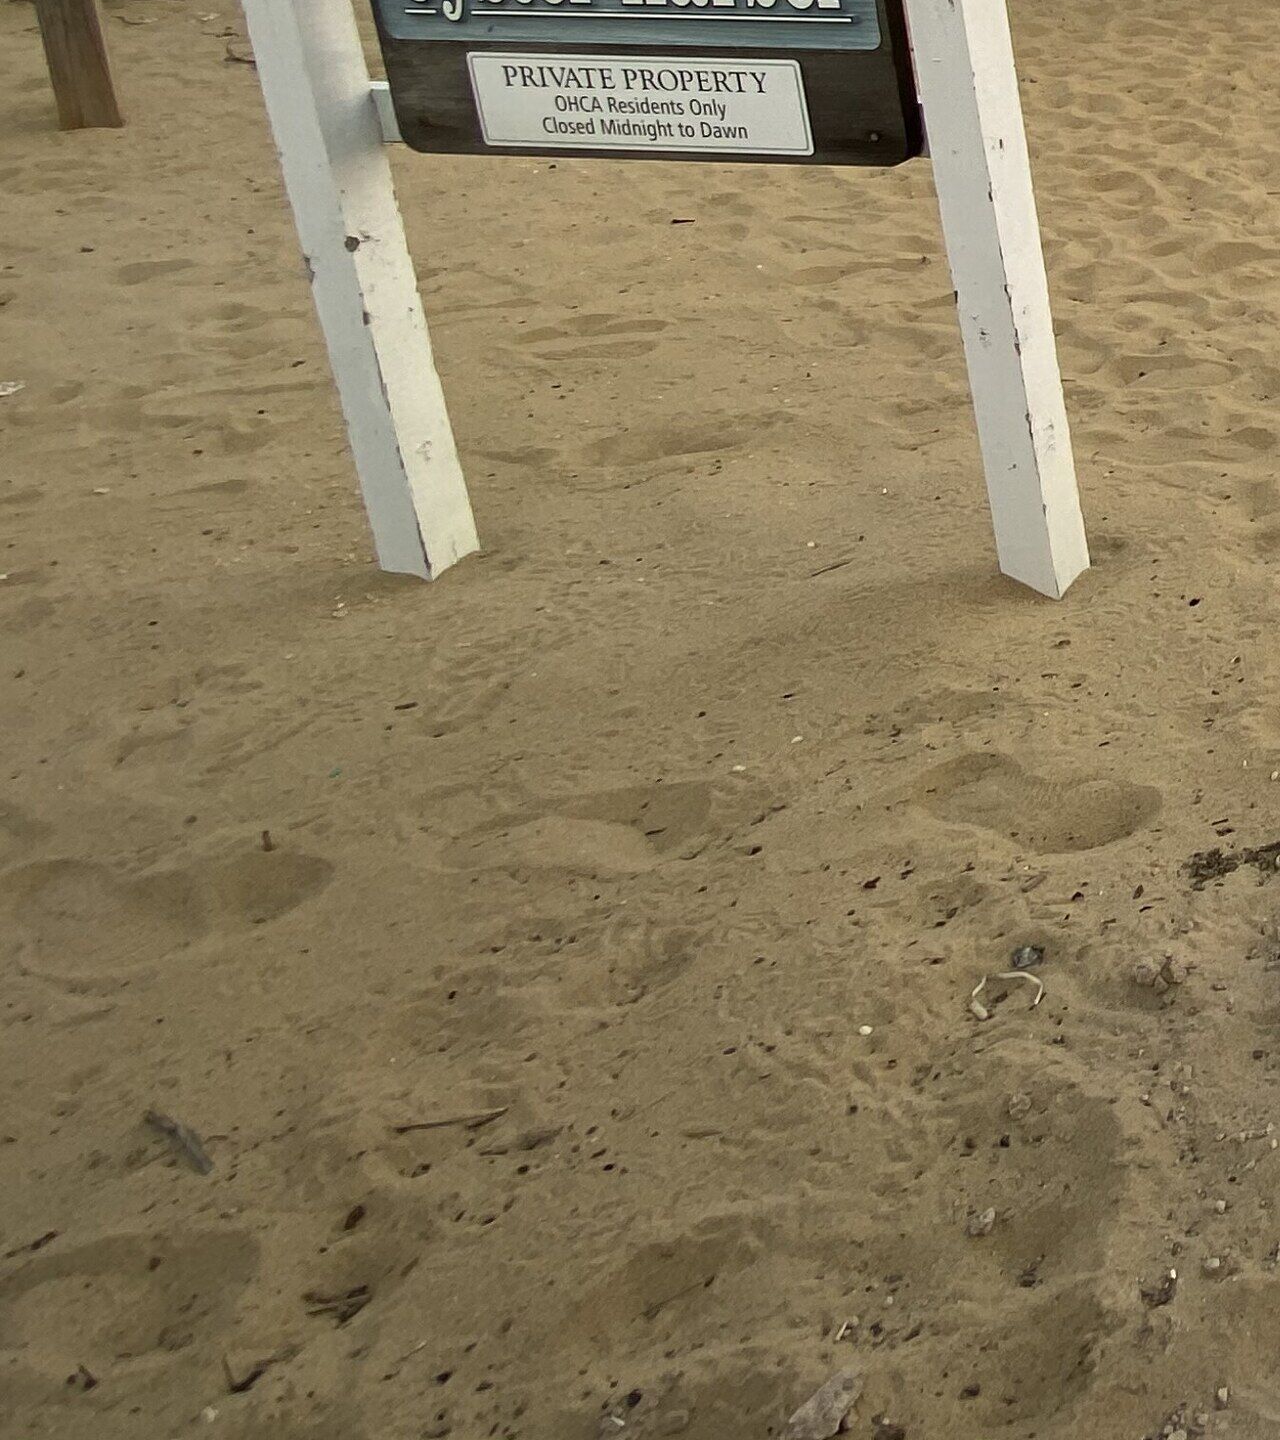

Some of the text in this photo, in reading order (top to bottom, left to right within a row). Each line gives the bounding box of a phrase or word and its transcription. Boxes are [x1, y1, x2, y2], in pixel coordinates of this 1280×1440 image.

[501, 65, 767, 93] PRIVATE PROPERTY
[555, 95, 726, 121] OHCA Residents Only
[543, 116, 748, 141] Closed Midnight to Dawn
